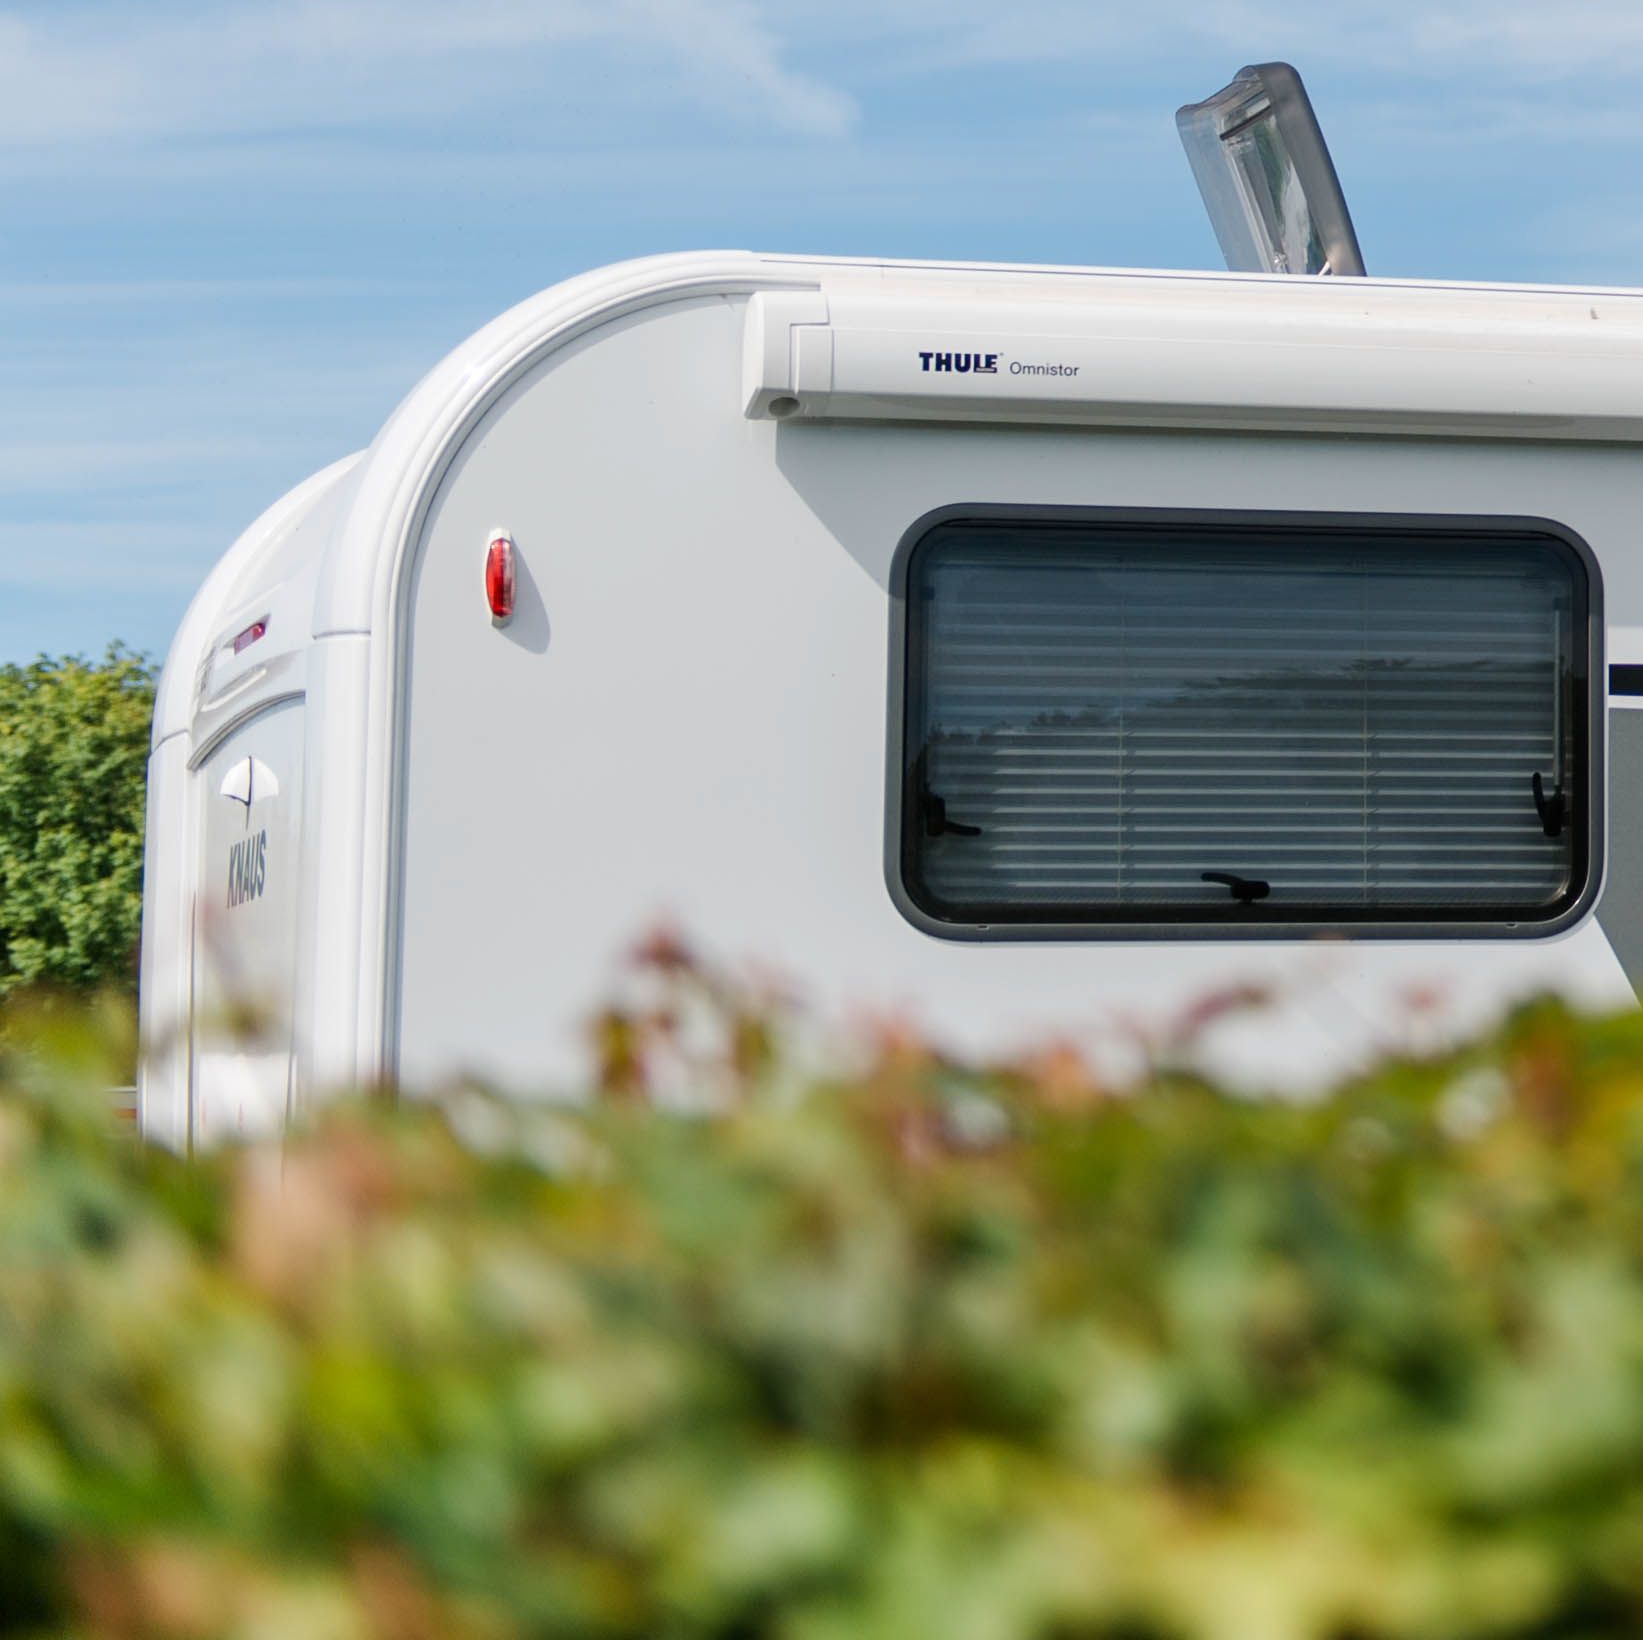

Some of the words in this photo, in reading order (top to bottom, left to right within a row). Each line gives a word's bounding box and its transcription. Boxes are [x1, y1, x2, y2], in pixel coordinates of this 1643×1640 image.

[919, 352, 998, 373] THULE
[1009, 361, 1080, 377] Omnistor
[226, 828, 267, 909] KNAUS
